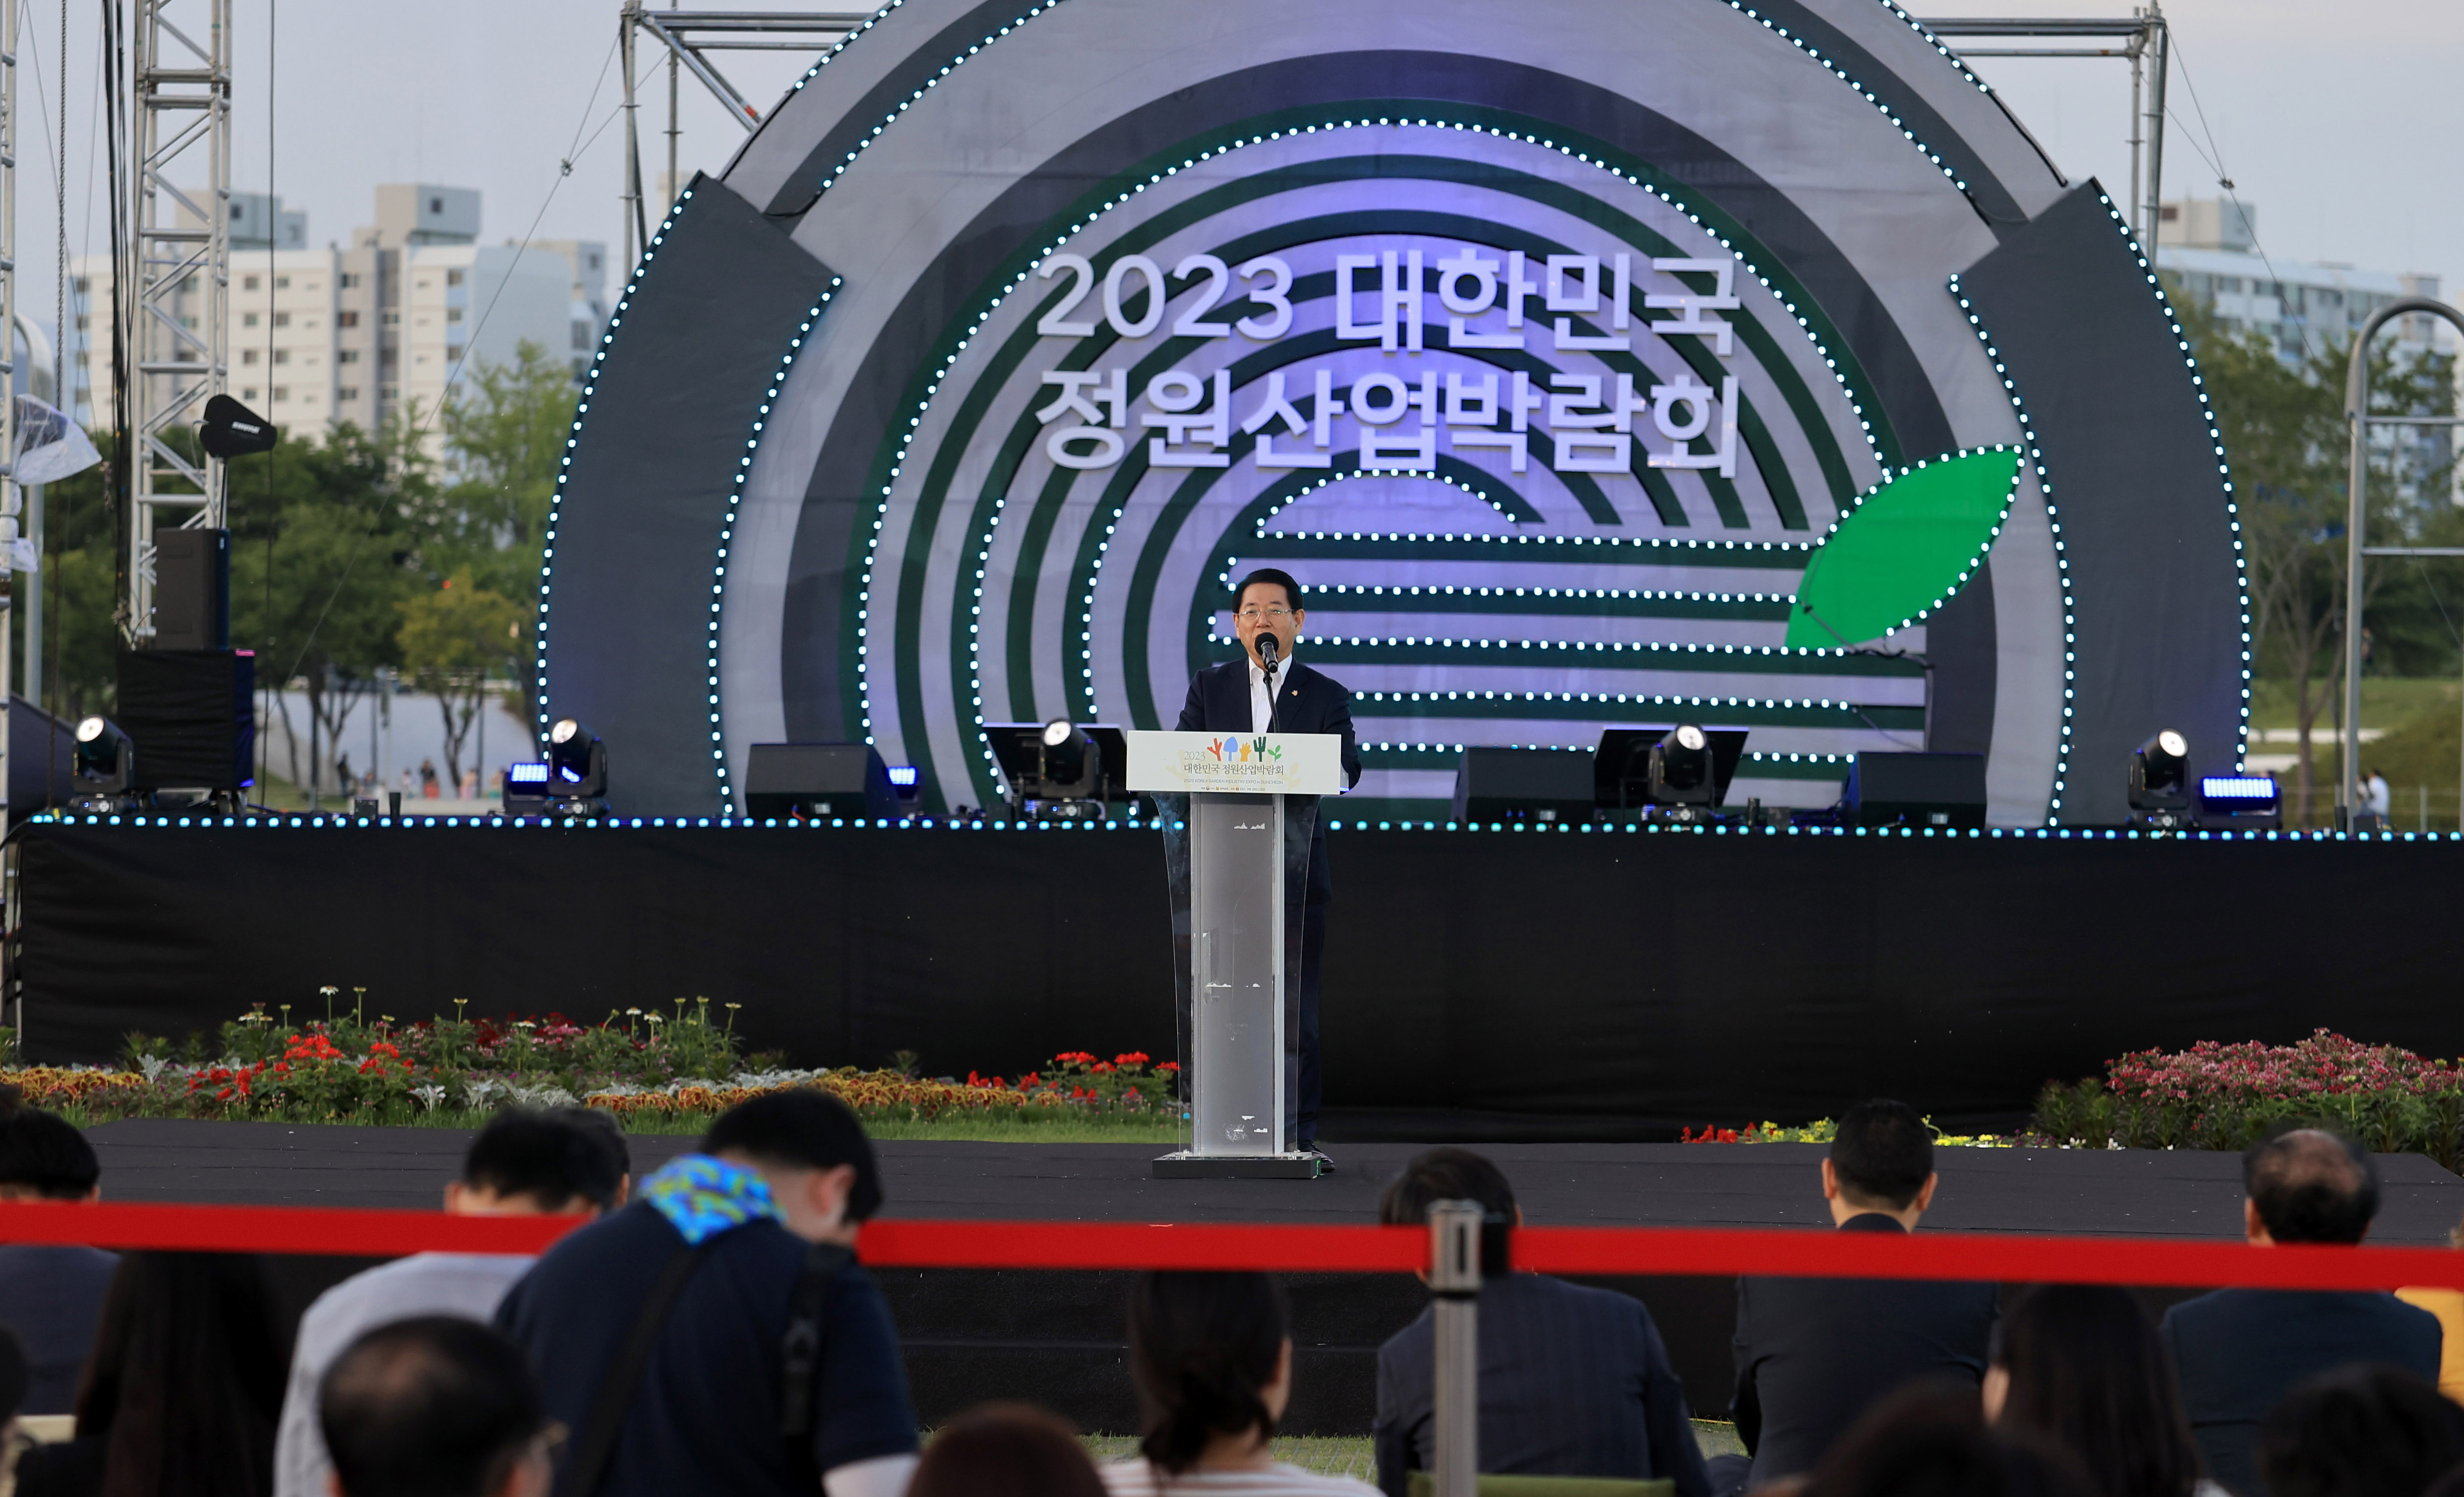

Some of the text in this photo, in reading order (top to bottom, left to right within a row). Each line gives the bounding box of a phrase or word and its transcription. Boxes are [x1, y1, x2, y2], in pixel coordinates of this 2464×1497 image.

[1036, 249, 1741, 356] 2023 대한민국
[1035, 368, 1740, 479] 정원산업박람회
[1184, 751, 1205, 761] 2023
[1184, 763, 1283, 776] 대한민국 정원산업박람회
